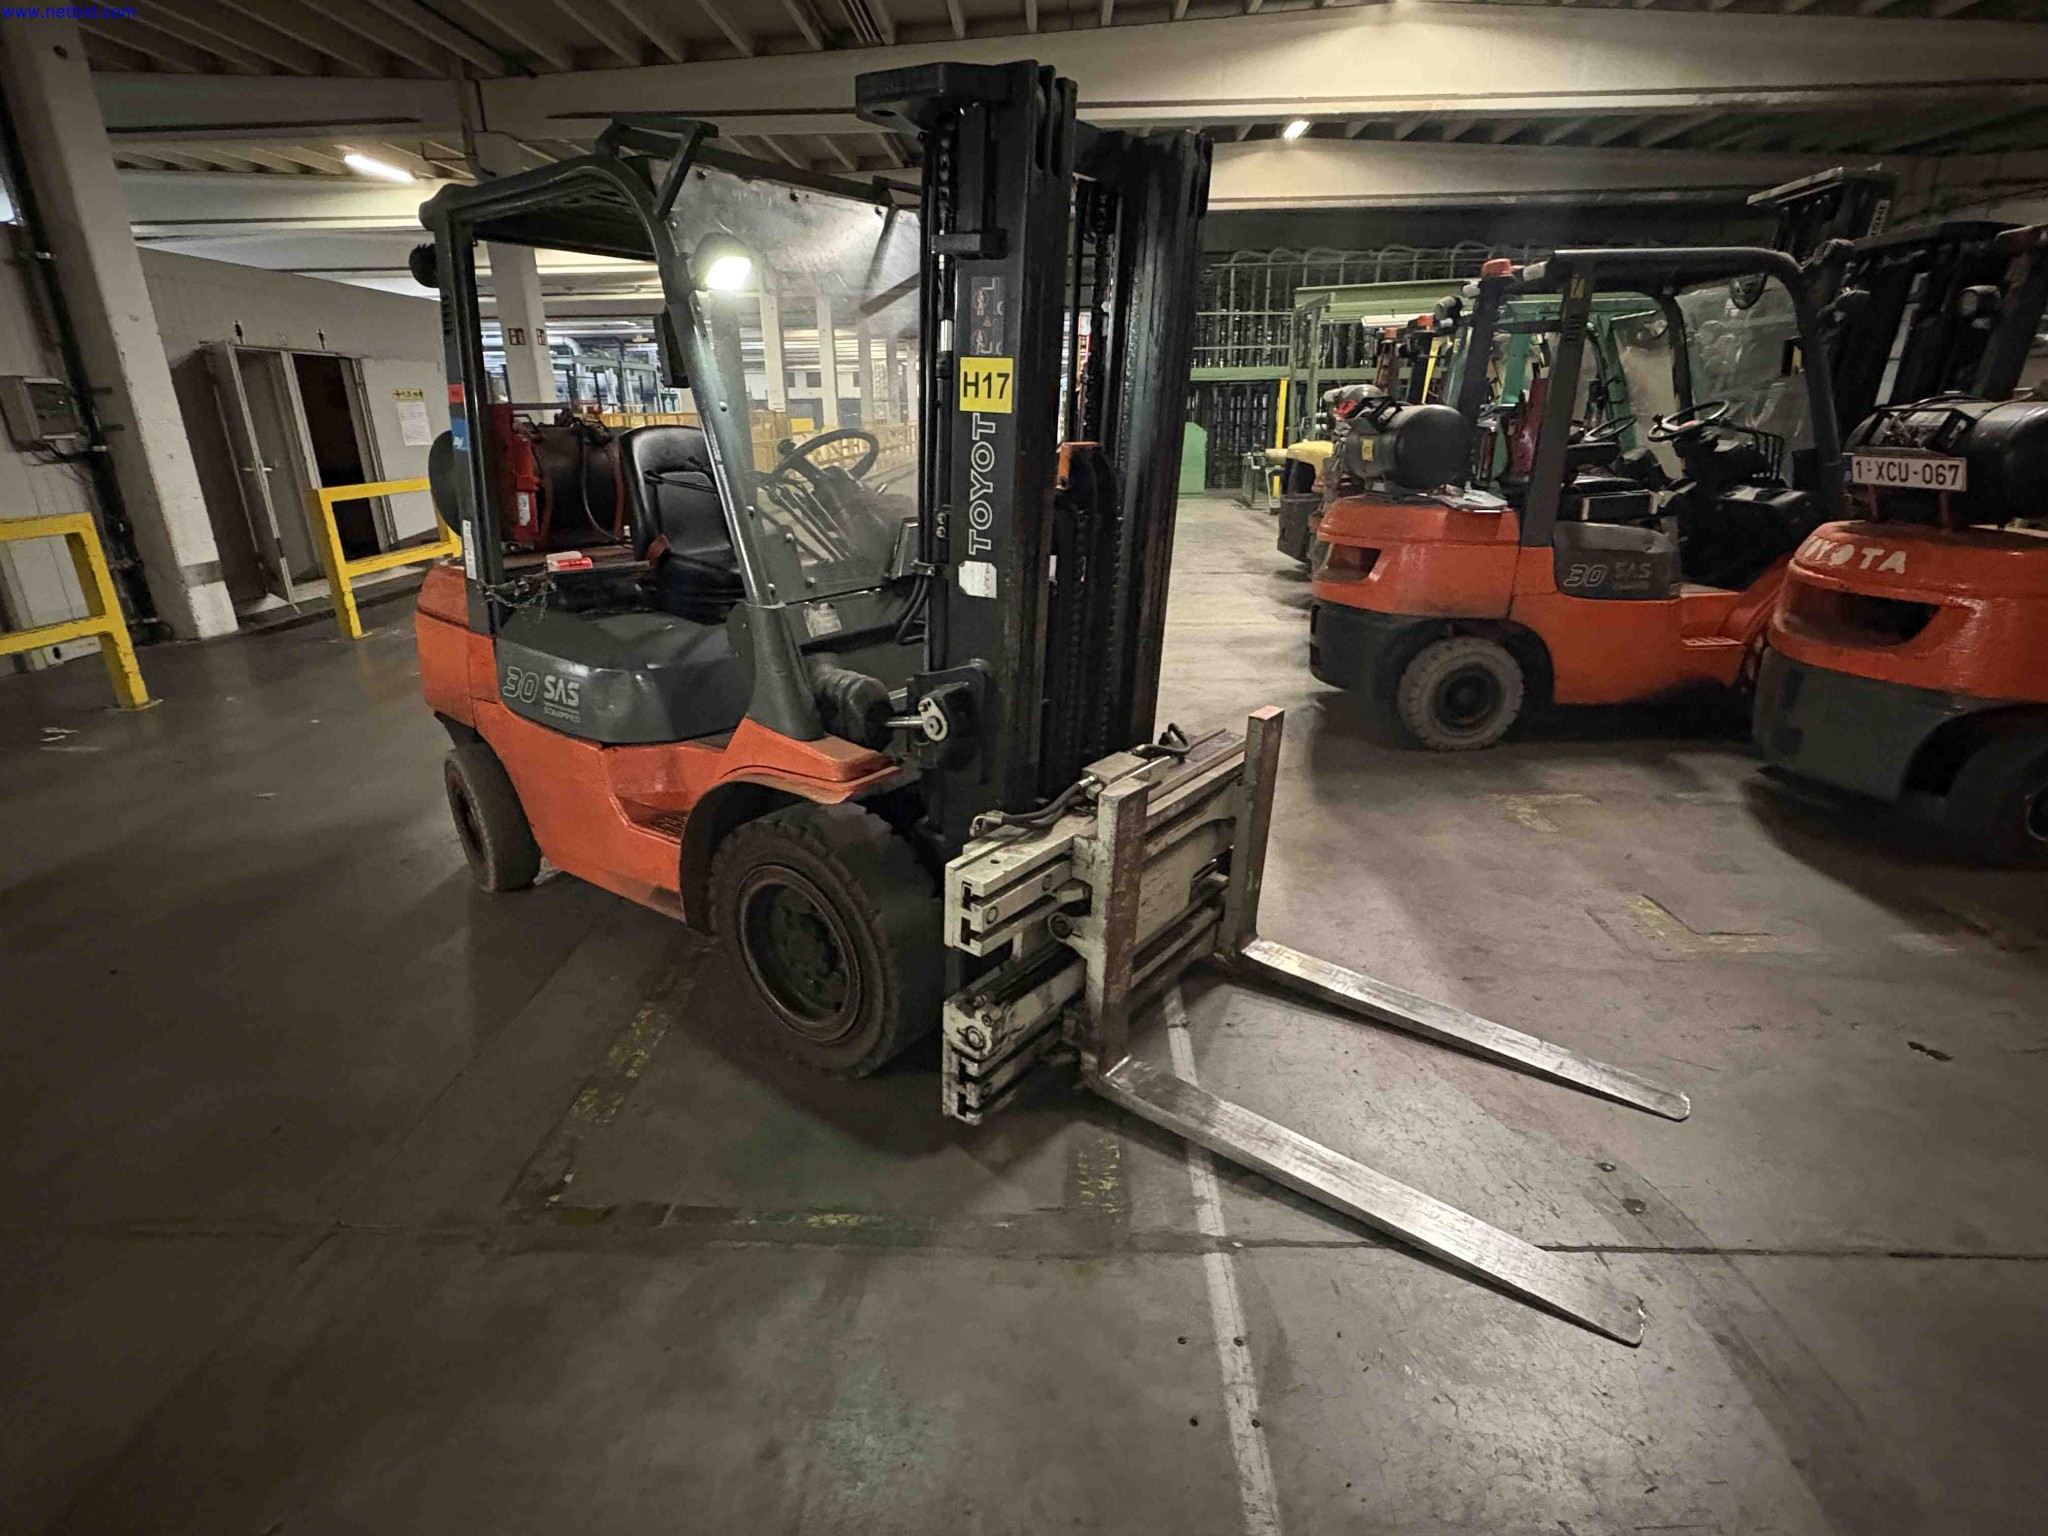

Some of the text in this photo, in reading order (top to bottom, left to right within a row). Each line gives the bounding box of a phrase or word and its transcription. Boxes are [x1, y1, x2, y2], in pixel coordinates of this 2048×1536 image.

[963, 371, 1010, 399] H17
[969, 412, 996, 556] TOYOT
[1563, 564, 1607, 587] 30
[502, 666, 580, 707] 30 SAS
